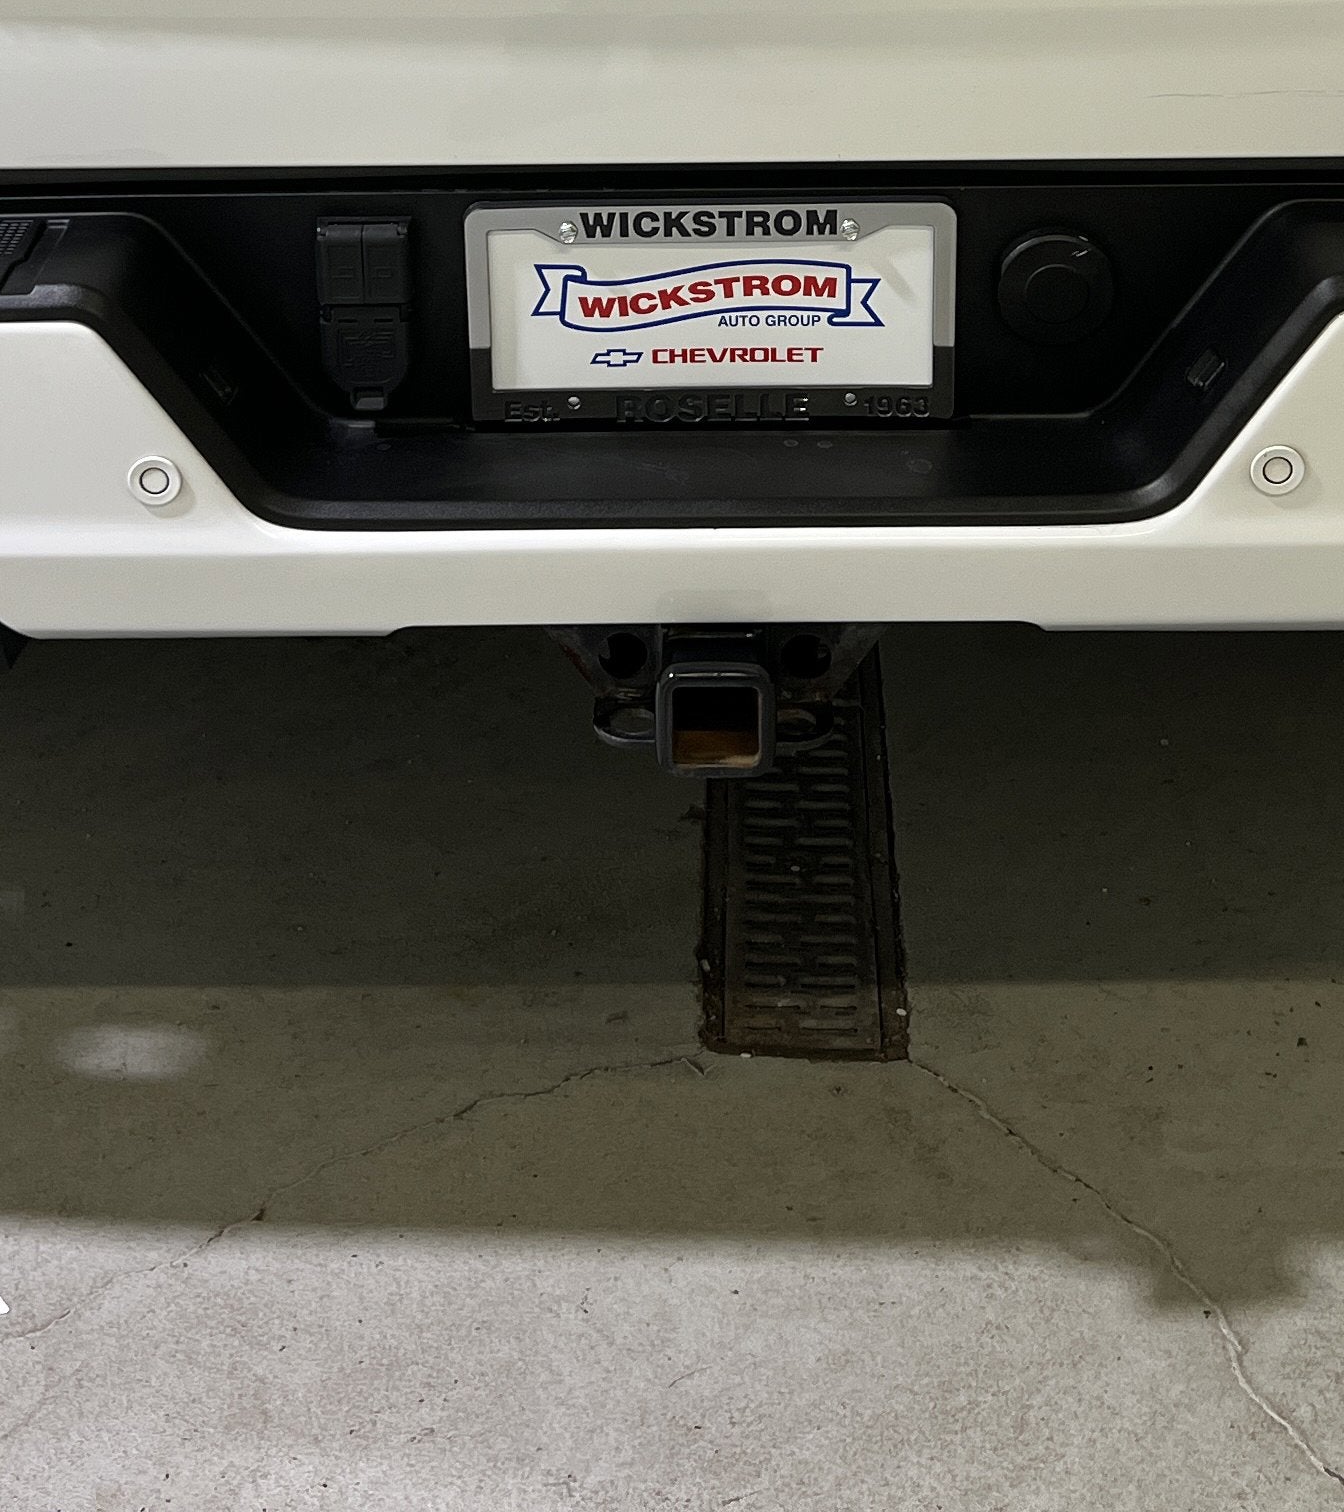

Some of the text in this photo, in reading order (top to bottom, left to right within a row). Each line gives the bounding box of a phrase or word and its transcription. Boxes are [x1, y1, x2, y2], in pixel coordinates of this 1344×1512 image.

[579, 209, 838, 239] WICKSTROM
[578, 274, 838, 319] WICKSTROM
[717, 314, 822, 328] AUTO GROUP
[651, 346, 824, 364] CHEVROLET
[503, 392, 931, 423] Est. ROSELLE 1963
